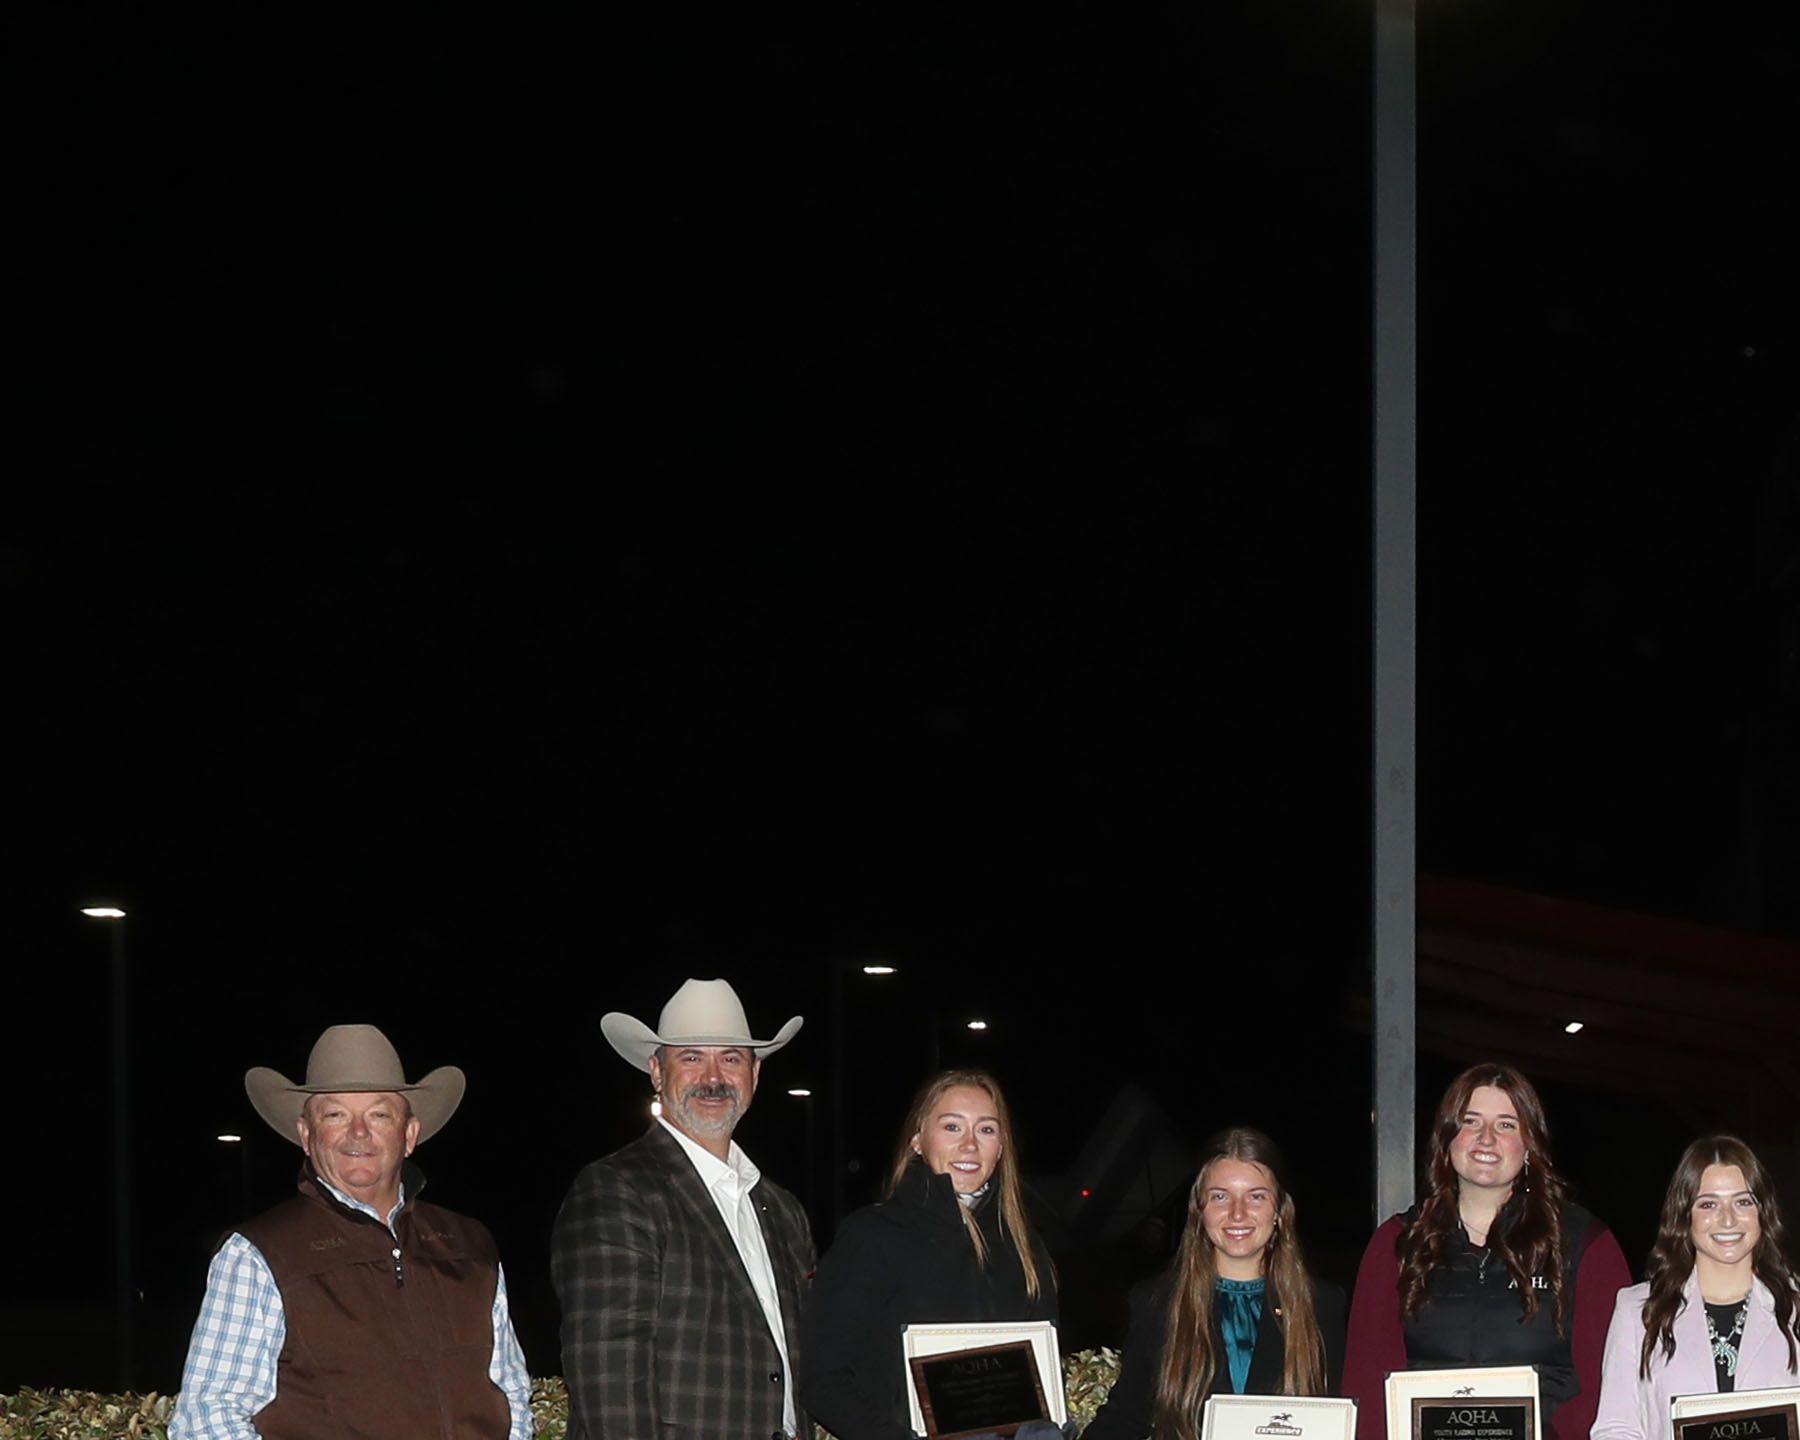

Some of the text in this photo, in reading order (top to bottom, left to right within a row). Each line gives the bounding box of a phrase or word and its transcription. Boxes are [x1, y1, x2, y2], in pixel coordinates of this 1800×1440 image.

[1507, 1276, 1548, 1289] AH
[1446, 1410, 1500, 1427] AQHA
[1256, 1427, 1301, 1436] EXPERIENCE
[1477, 1428, 1513, 1436] EXPERIENCE
[1709, 1421, 1761, 1440] AQHA
